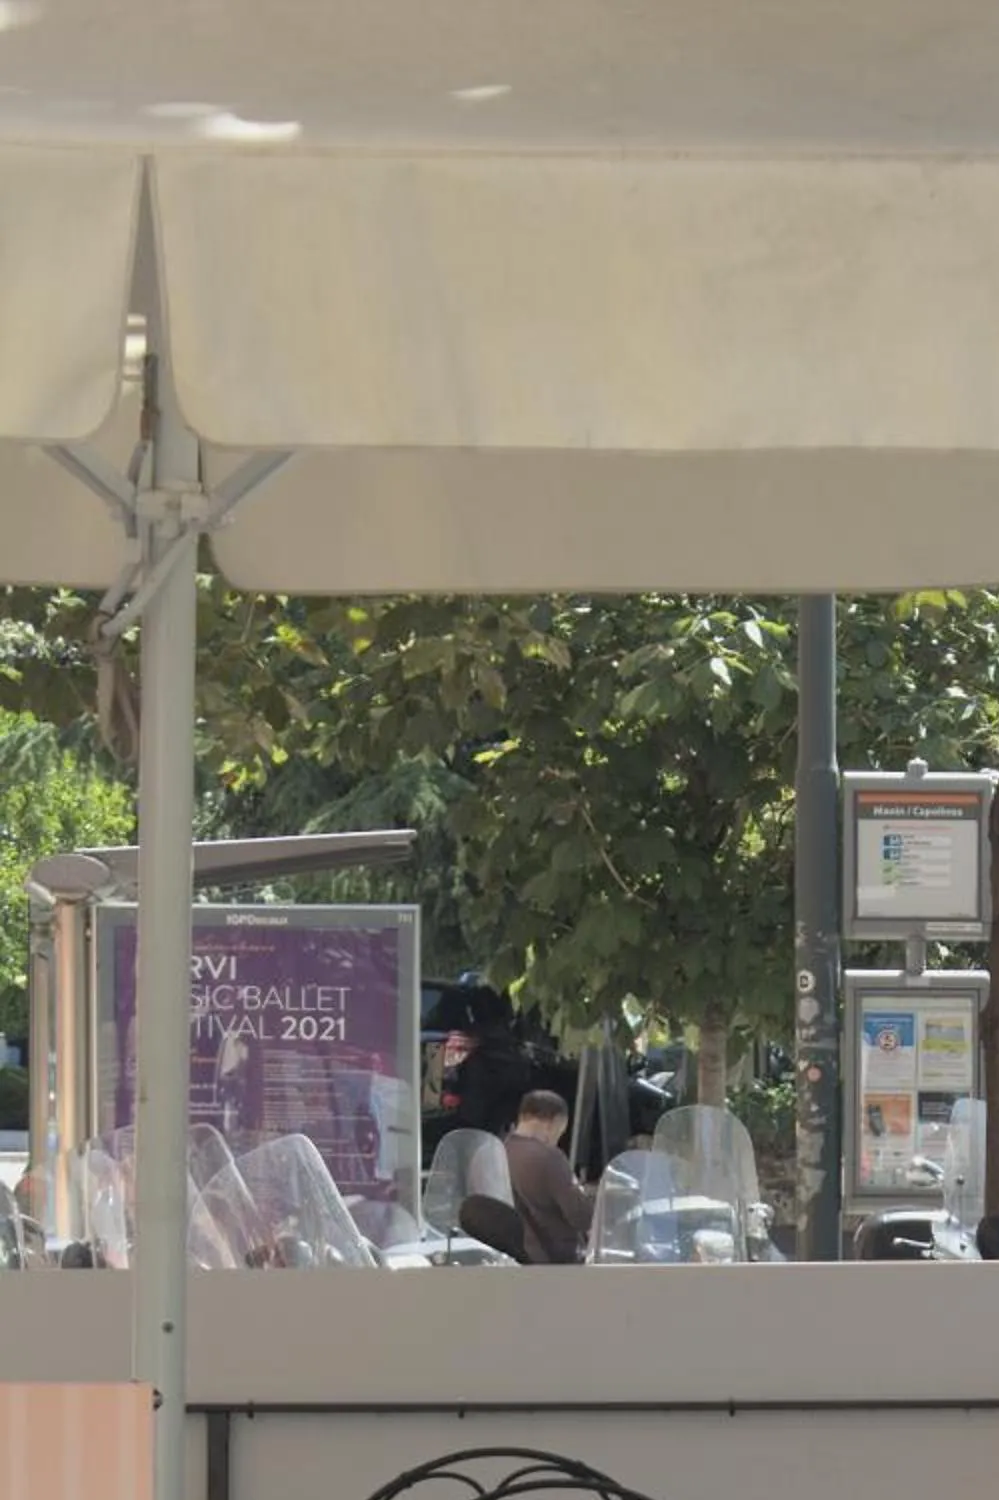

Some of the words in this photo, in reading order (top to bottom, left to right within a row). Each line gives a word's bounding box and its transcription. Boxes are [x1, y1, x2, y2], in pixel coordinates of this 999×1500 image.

[190, 955, 237, 980] RVI
[190, 984, 236, 1010] SIC
[243, 985, 352, 1011] BALLET
[190, 1014, 274, 1039] TIVAL
[281, 1015, 346, 1041] 2021
